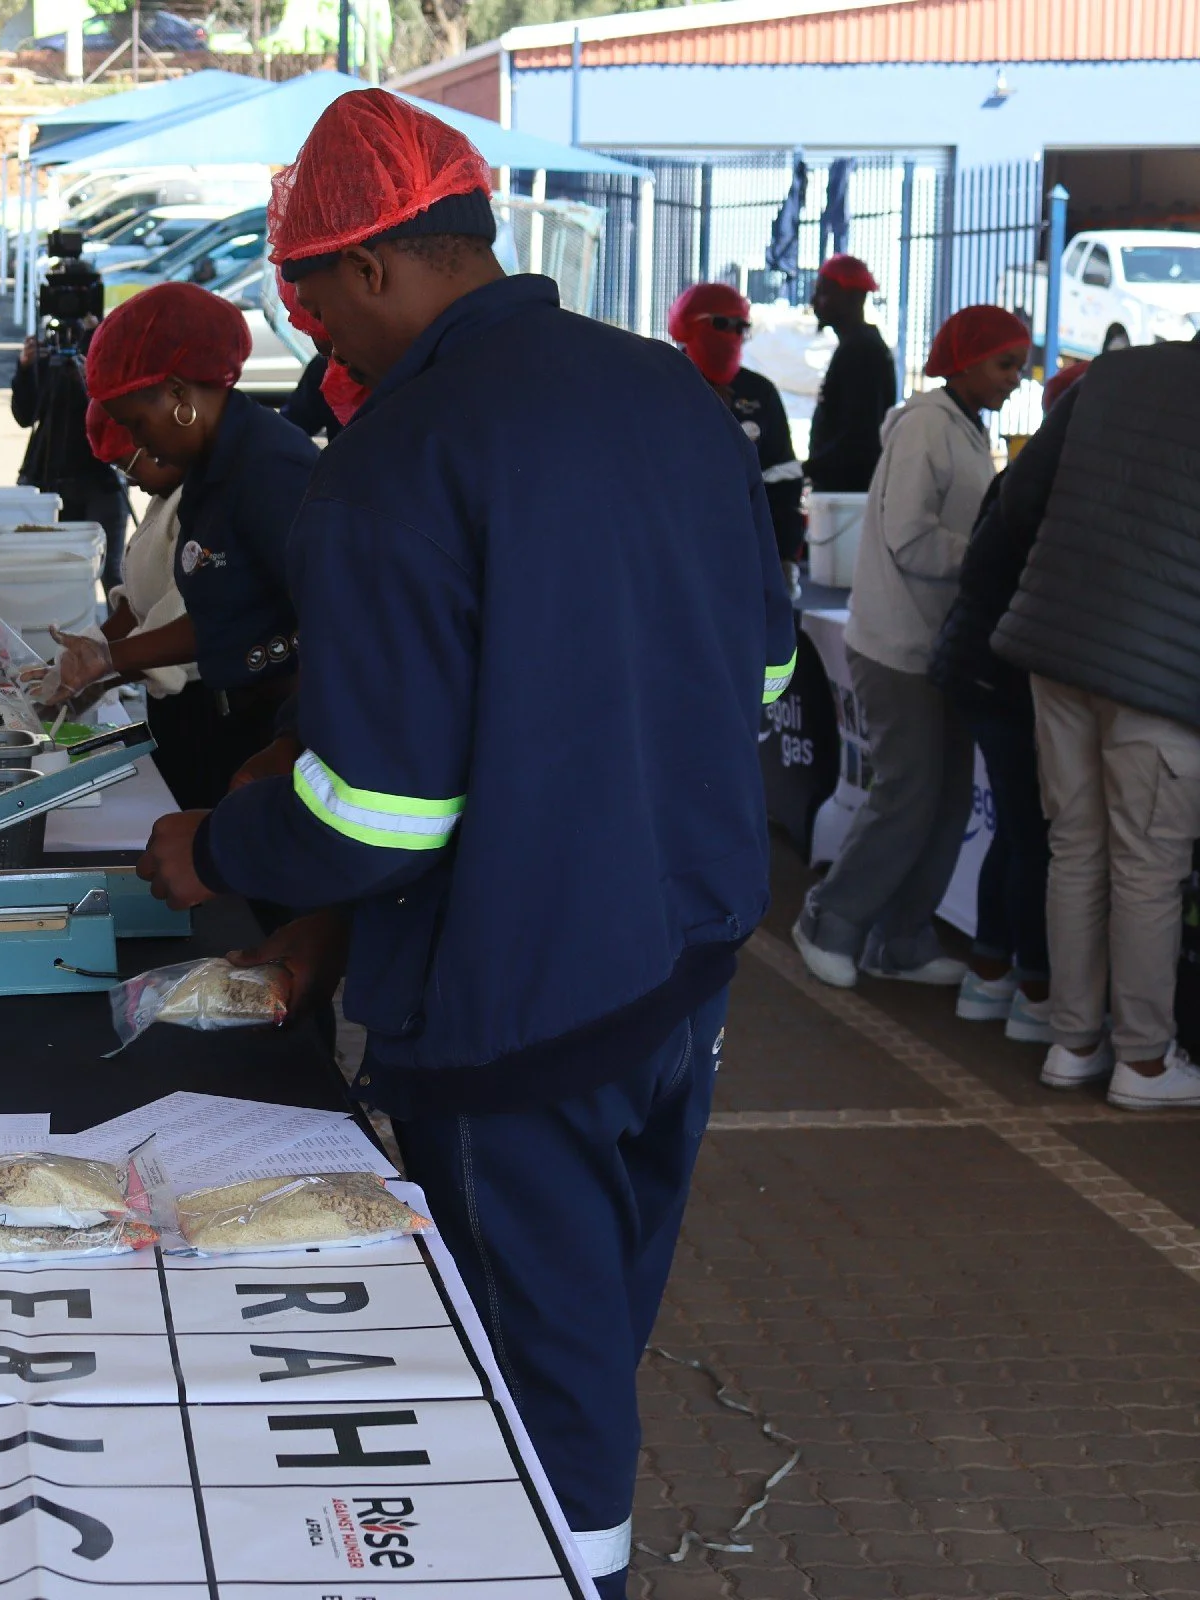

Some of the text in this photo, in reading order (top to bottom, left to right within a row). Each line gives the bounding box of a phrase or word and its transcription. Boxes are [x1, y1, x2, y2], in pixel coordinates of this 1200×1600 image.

[780, 732, 815, 767] gas
[305, 1517, 324, 1547] AFRICA
[331, 1497, 355, 1532] AGAINST
[351, 1497, 419, 1569] Rise
[341, 1534, 365, 1569] HUNGER
